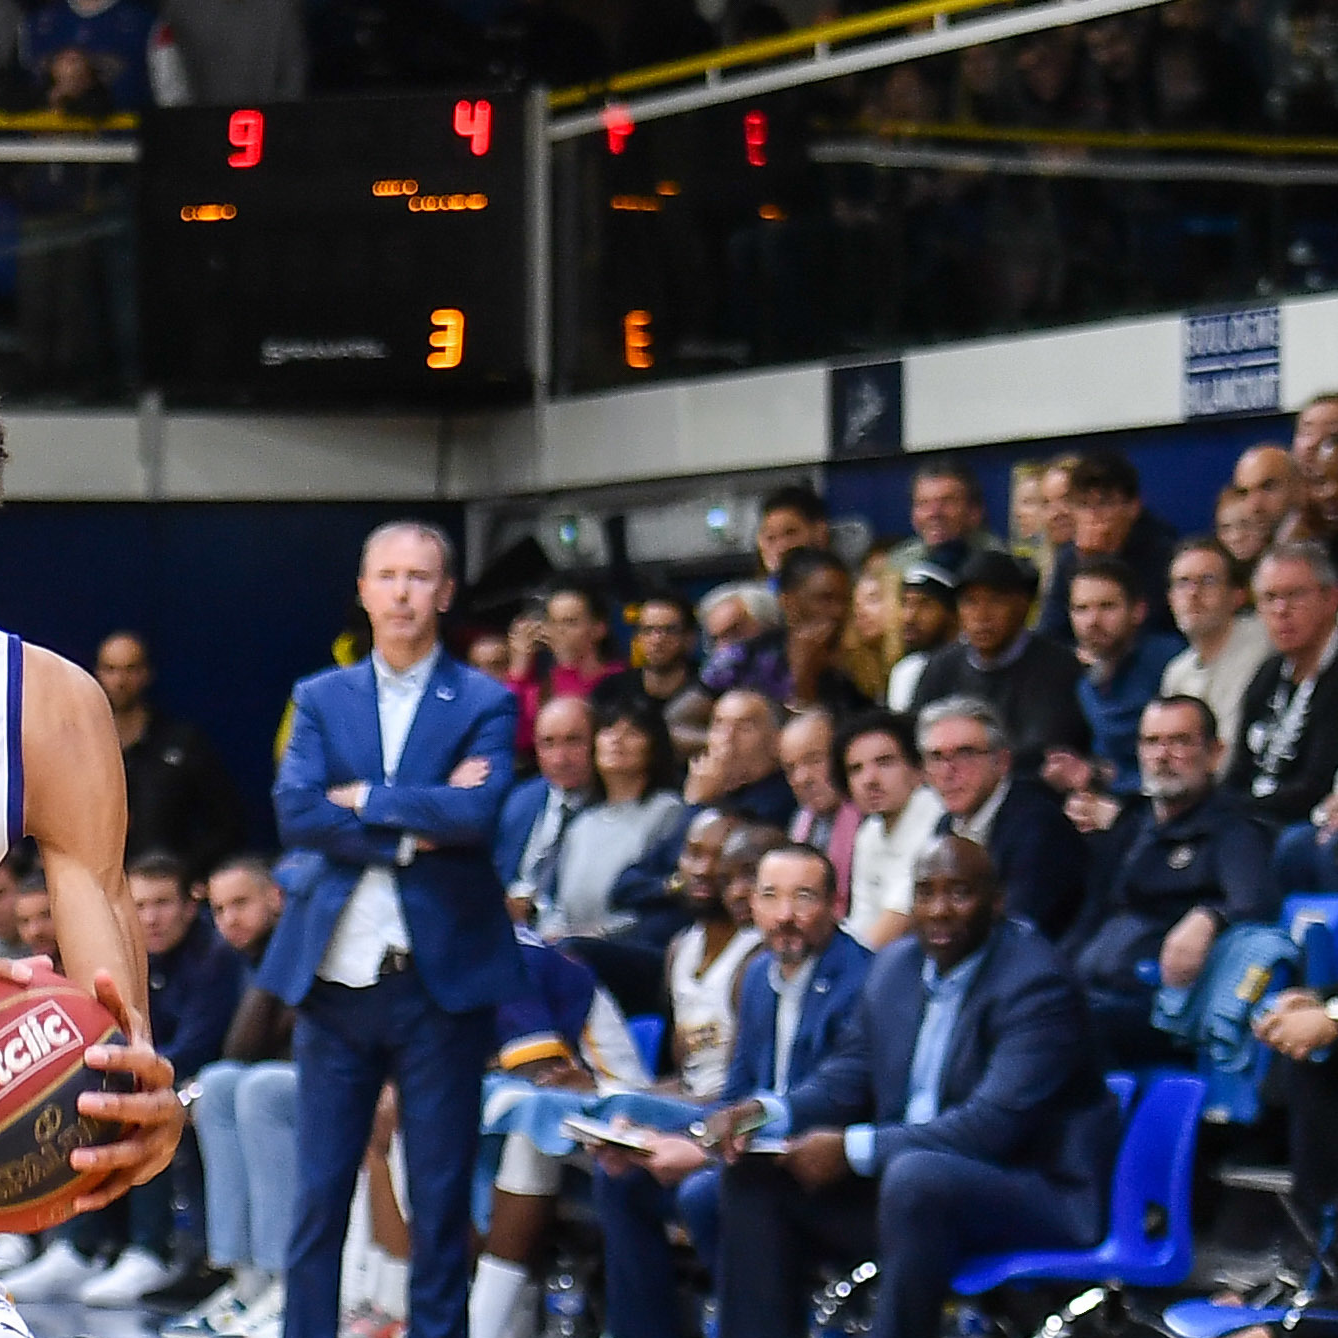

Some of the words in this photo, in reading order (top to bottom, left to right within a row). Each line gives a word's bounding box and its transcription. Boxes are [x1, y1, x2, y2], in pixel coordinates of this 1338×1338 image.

[227, 109, 264, 168] 9
[454, 99, 491, 156] 4
[427, 308, 465, 369] 3
